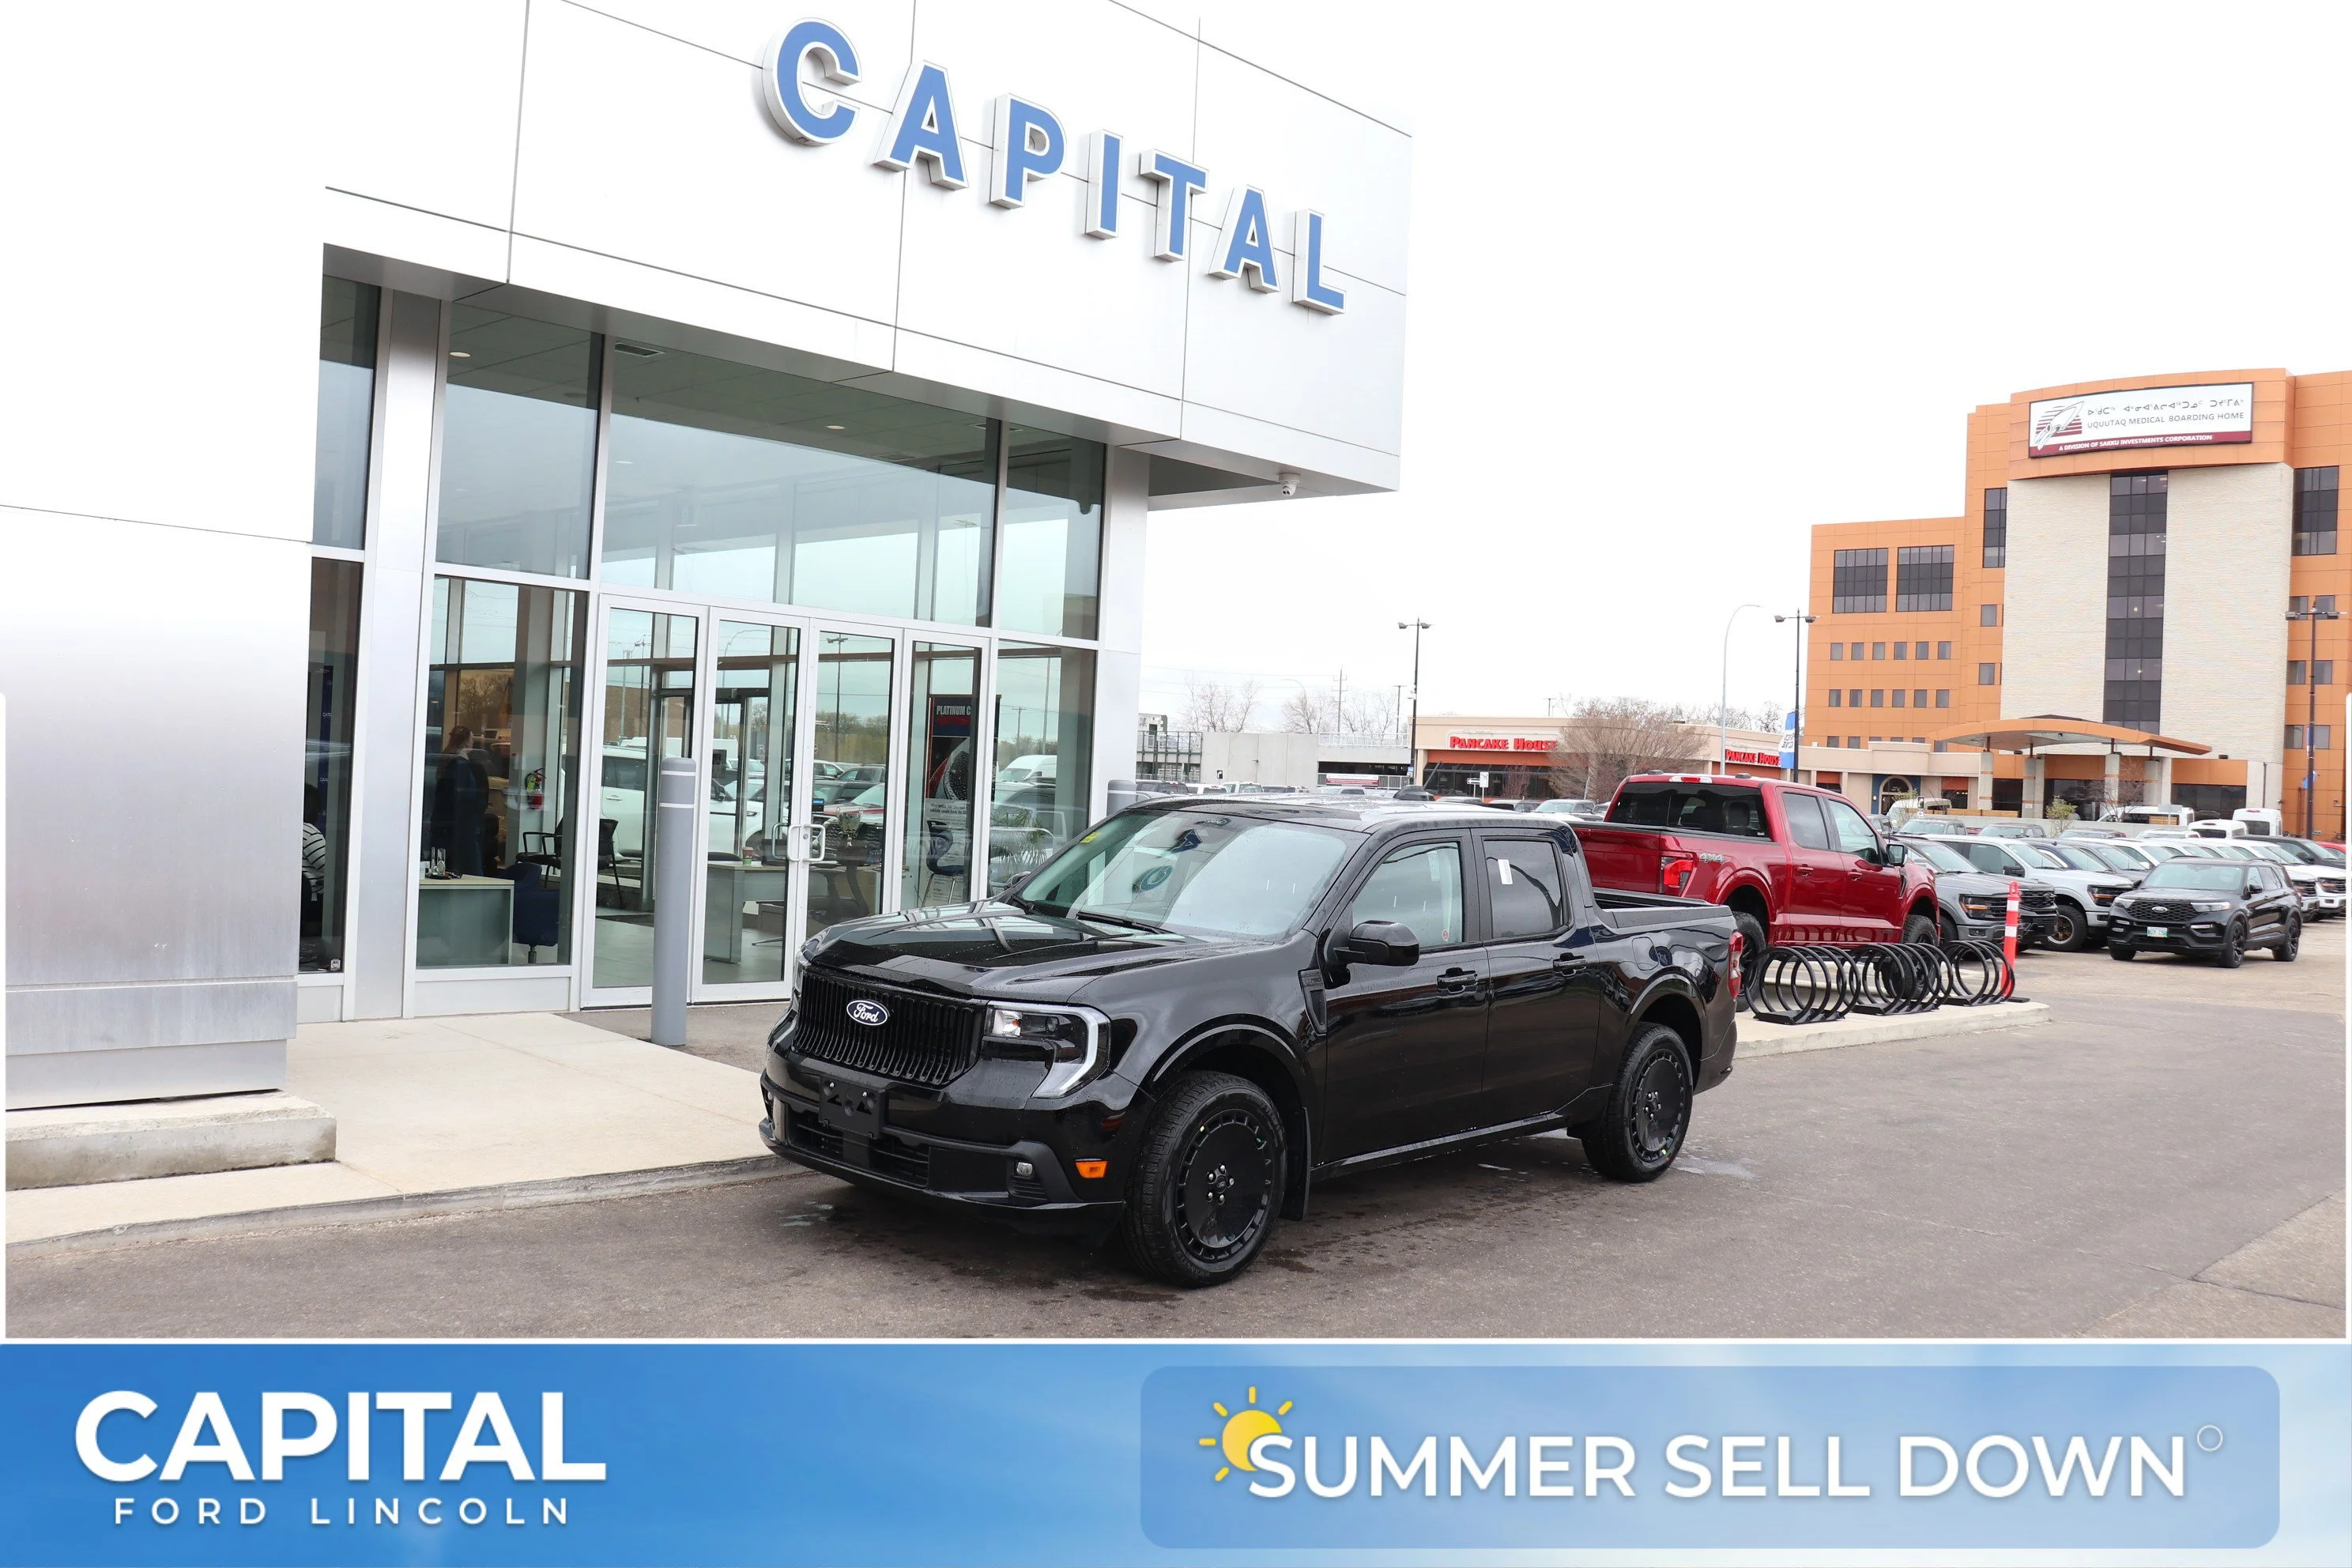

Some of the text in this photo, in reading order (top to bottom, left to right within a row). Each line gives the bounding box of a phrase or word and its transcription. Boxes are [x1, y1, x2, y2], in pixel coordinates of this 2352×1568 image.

[765, 17, 1346, 315] CAPITAL
[2087, 419, 2127, 429] UQUUTAQ
[2128, 416, 2165, 425] MEDICAL
[2169, 413, 2214, 422] BOARDING
[2120, 436, 2164, 445] INVESTMENTS
[937, 705, 971, 715] PLATINUM C
[1449, 736, 1510, 750] PANCAKE
[1724, 748, 1758, 763] PANCAKE
[854, 1003, 880, 1023] Ford
